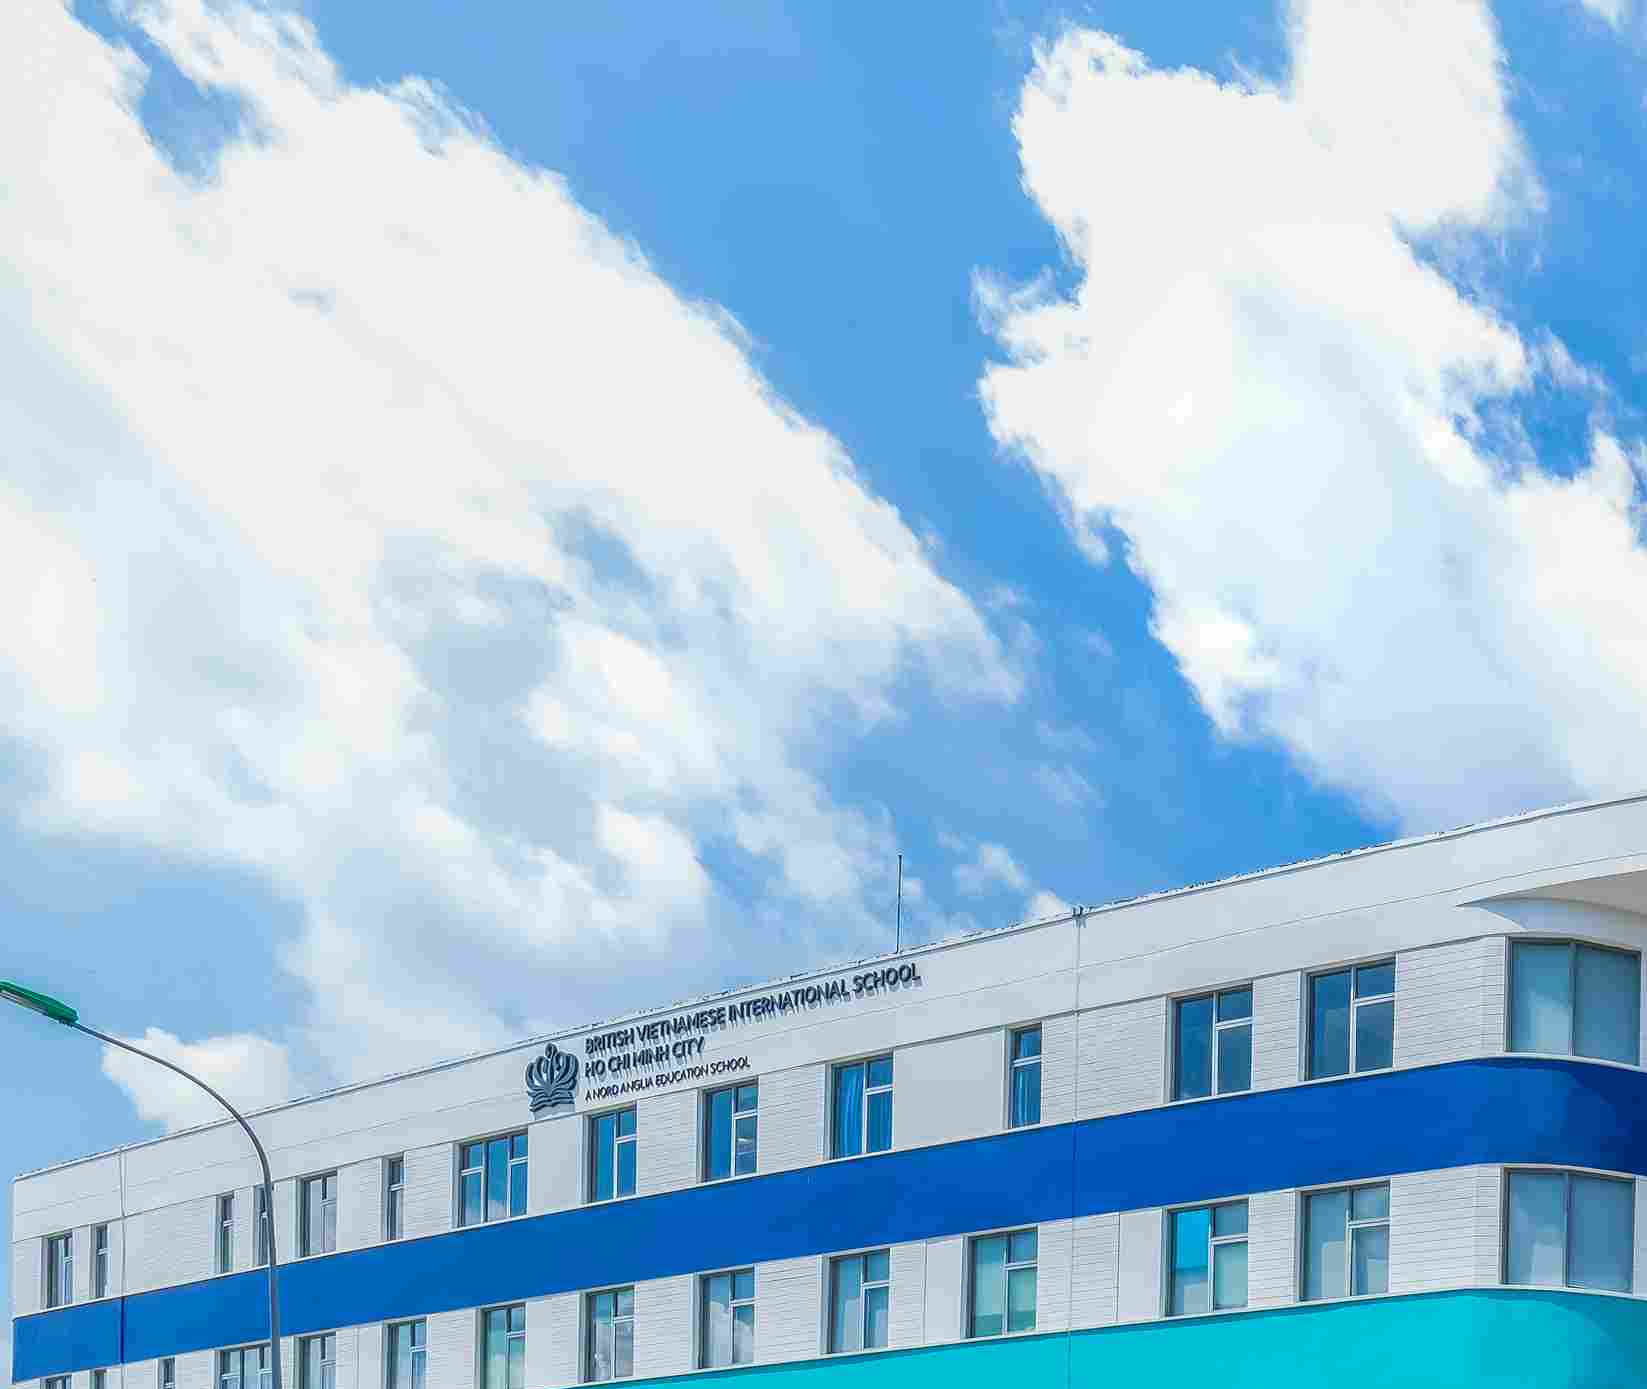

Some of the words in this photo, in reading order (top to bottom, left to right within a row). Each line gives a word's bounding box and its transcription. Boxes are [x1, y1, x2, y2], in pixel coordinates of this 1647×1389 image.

[585, 1028, 635, 1054] BRITISH
[636, 1007, 726, 1041] VIETNAMESE
[728, 979, 850, 1023] INTERNATIONAL
[852, 963, 921, 993] SCHOOL
[585, 1060, 606, 1079] HO
[608, 1053, 631, 1073] CHI
[632, 1044, 669, 1067] MINH
[671, 1036, 705, 1059] CITY
[585, 1089, 592, 1102] A
[593, 1085, 619, 1099] NORD
[620, 1078, 655, 1096] ANGLIA
[655, 1064, 709, 1088] EDUCATION
[710, 1056, 751, 1075] SCHOOL
